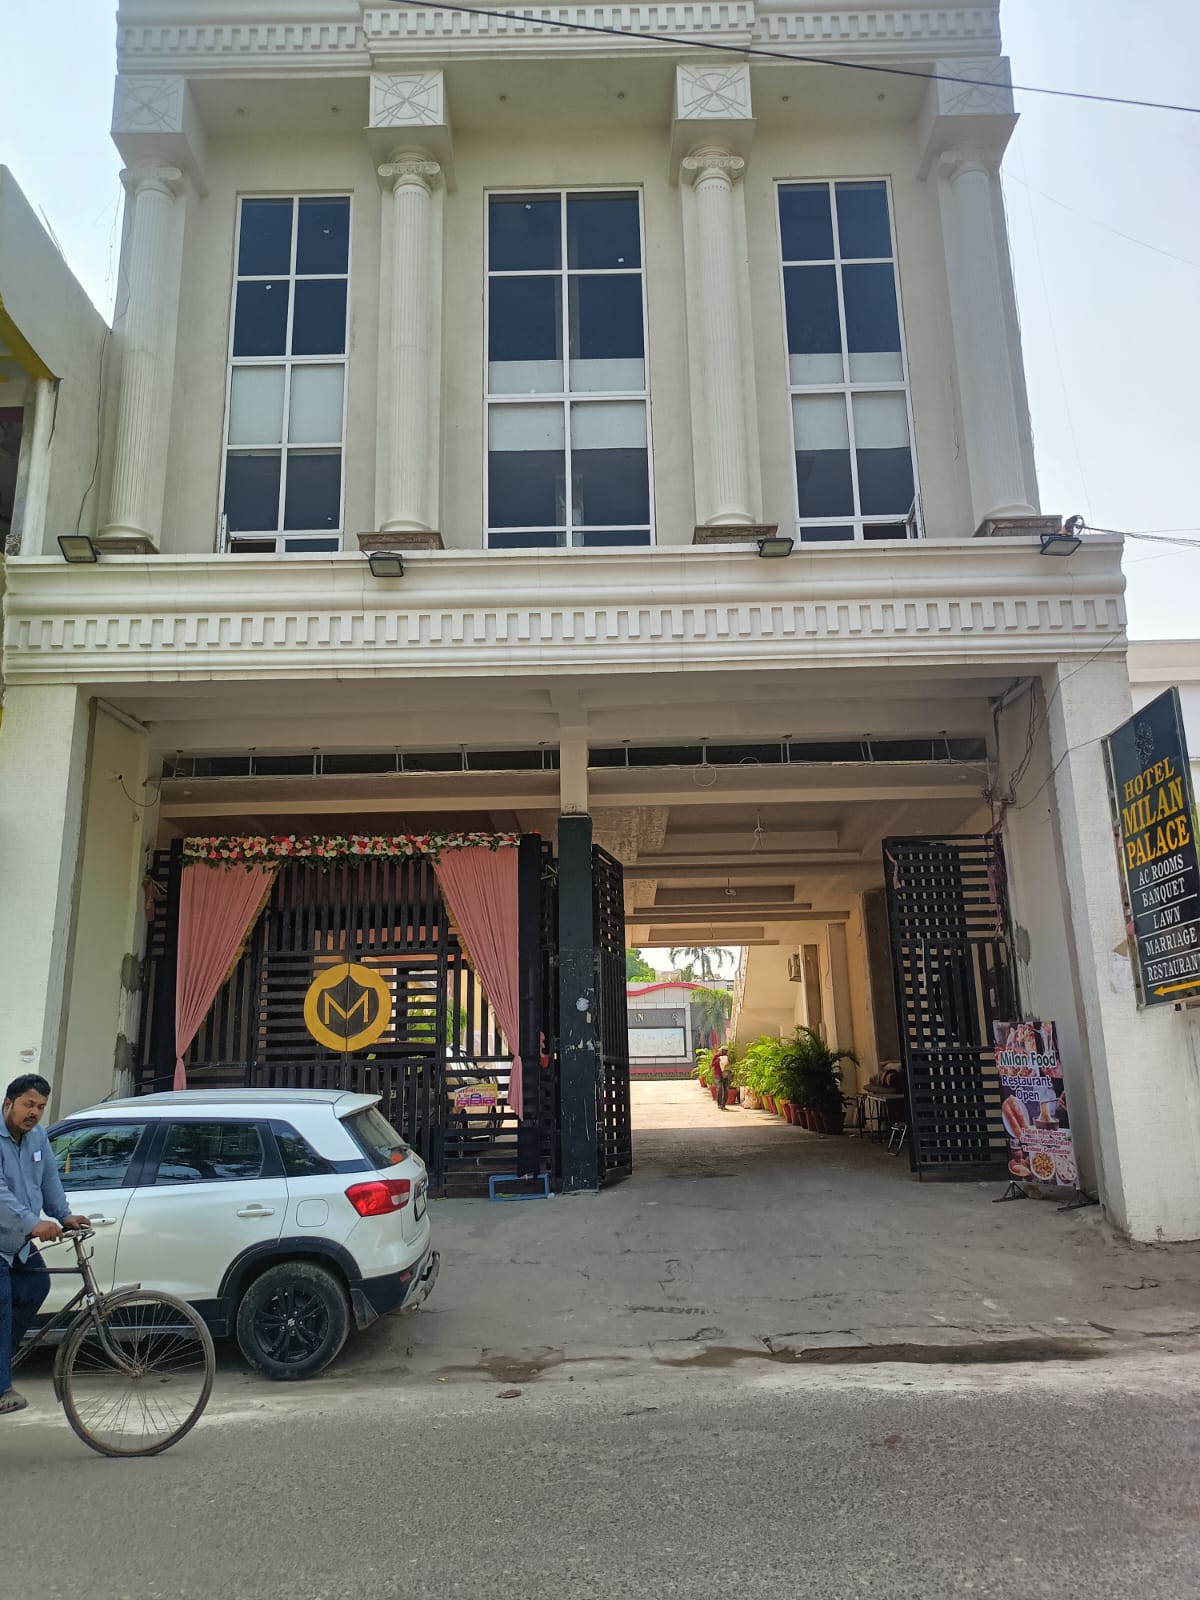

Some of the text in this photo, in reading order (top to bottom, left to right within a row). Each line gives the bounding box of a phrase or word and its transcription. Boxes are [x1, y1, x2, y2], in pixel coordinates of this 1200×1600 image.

[1124, 757, 1175, 802] HOTEL
[1122, 776, 1184, 838] MILAN
[1126, 815, 1190, 870] PALACE
[1139, 854, 1184, 886] AC ROOMS
[1142, 877, 1185, 907] BANQUET
[1153, 906, 1181, 929] LAWN
[1145, 927, 1198, 956] MARRIAGE
[1000, 1051, 1056, 1067] Milan Food
[1002, 1075, 1051, 1087] Restaurant
[1016, 1089, 1040, 1103] Open
